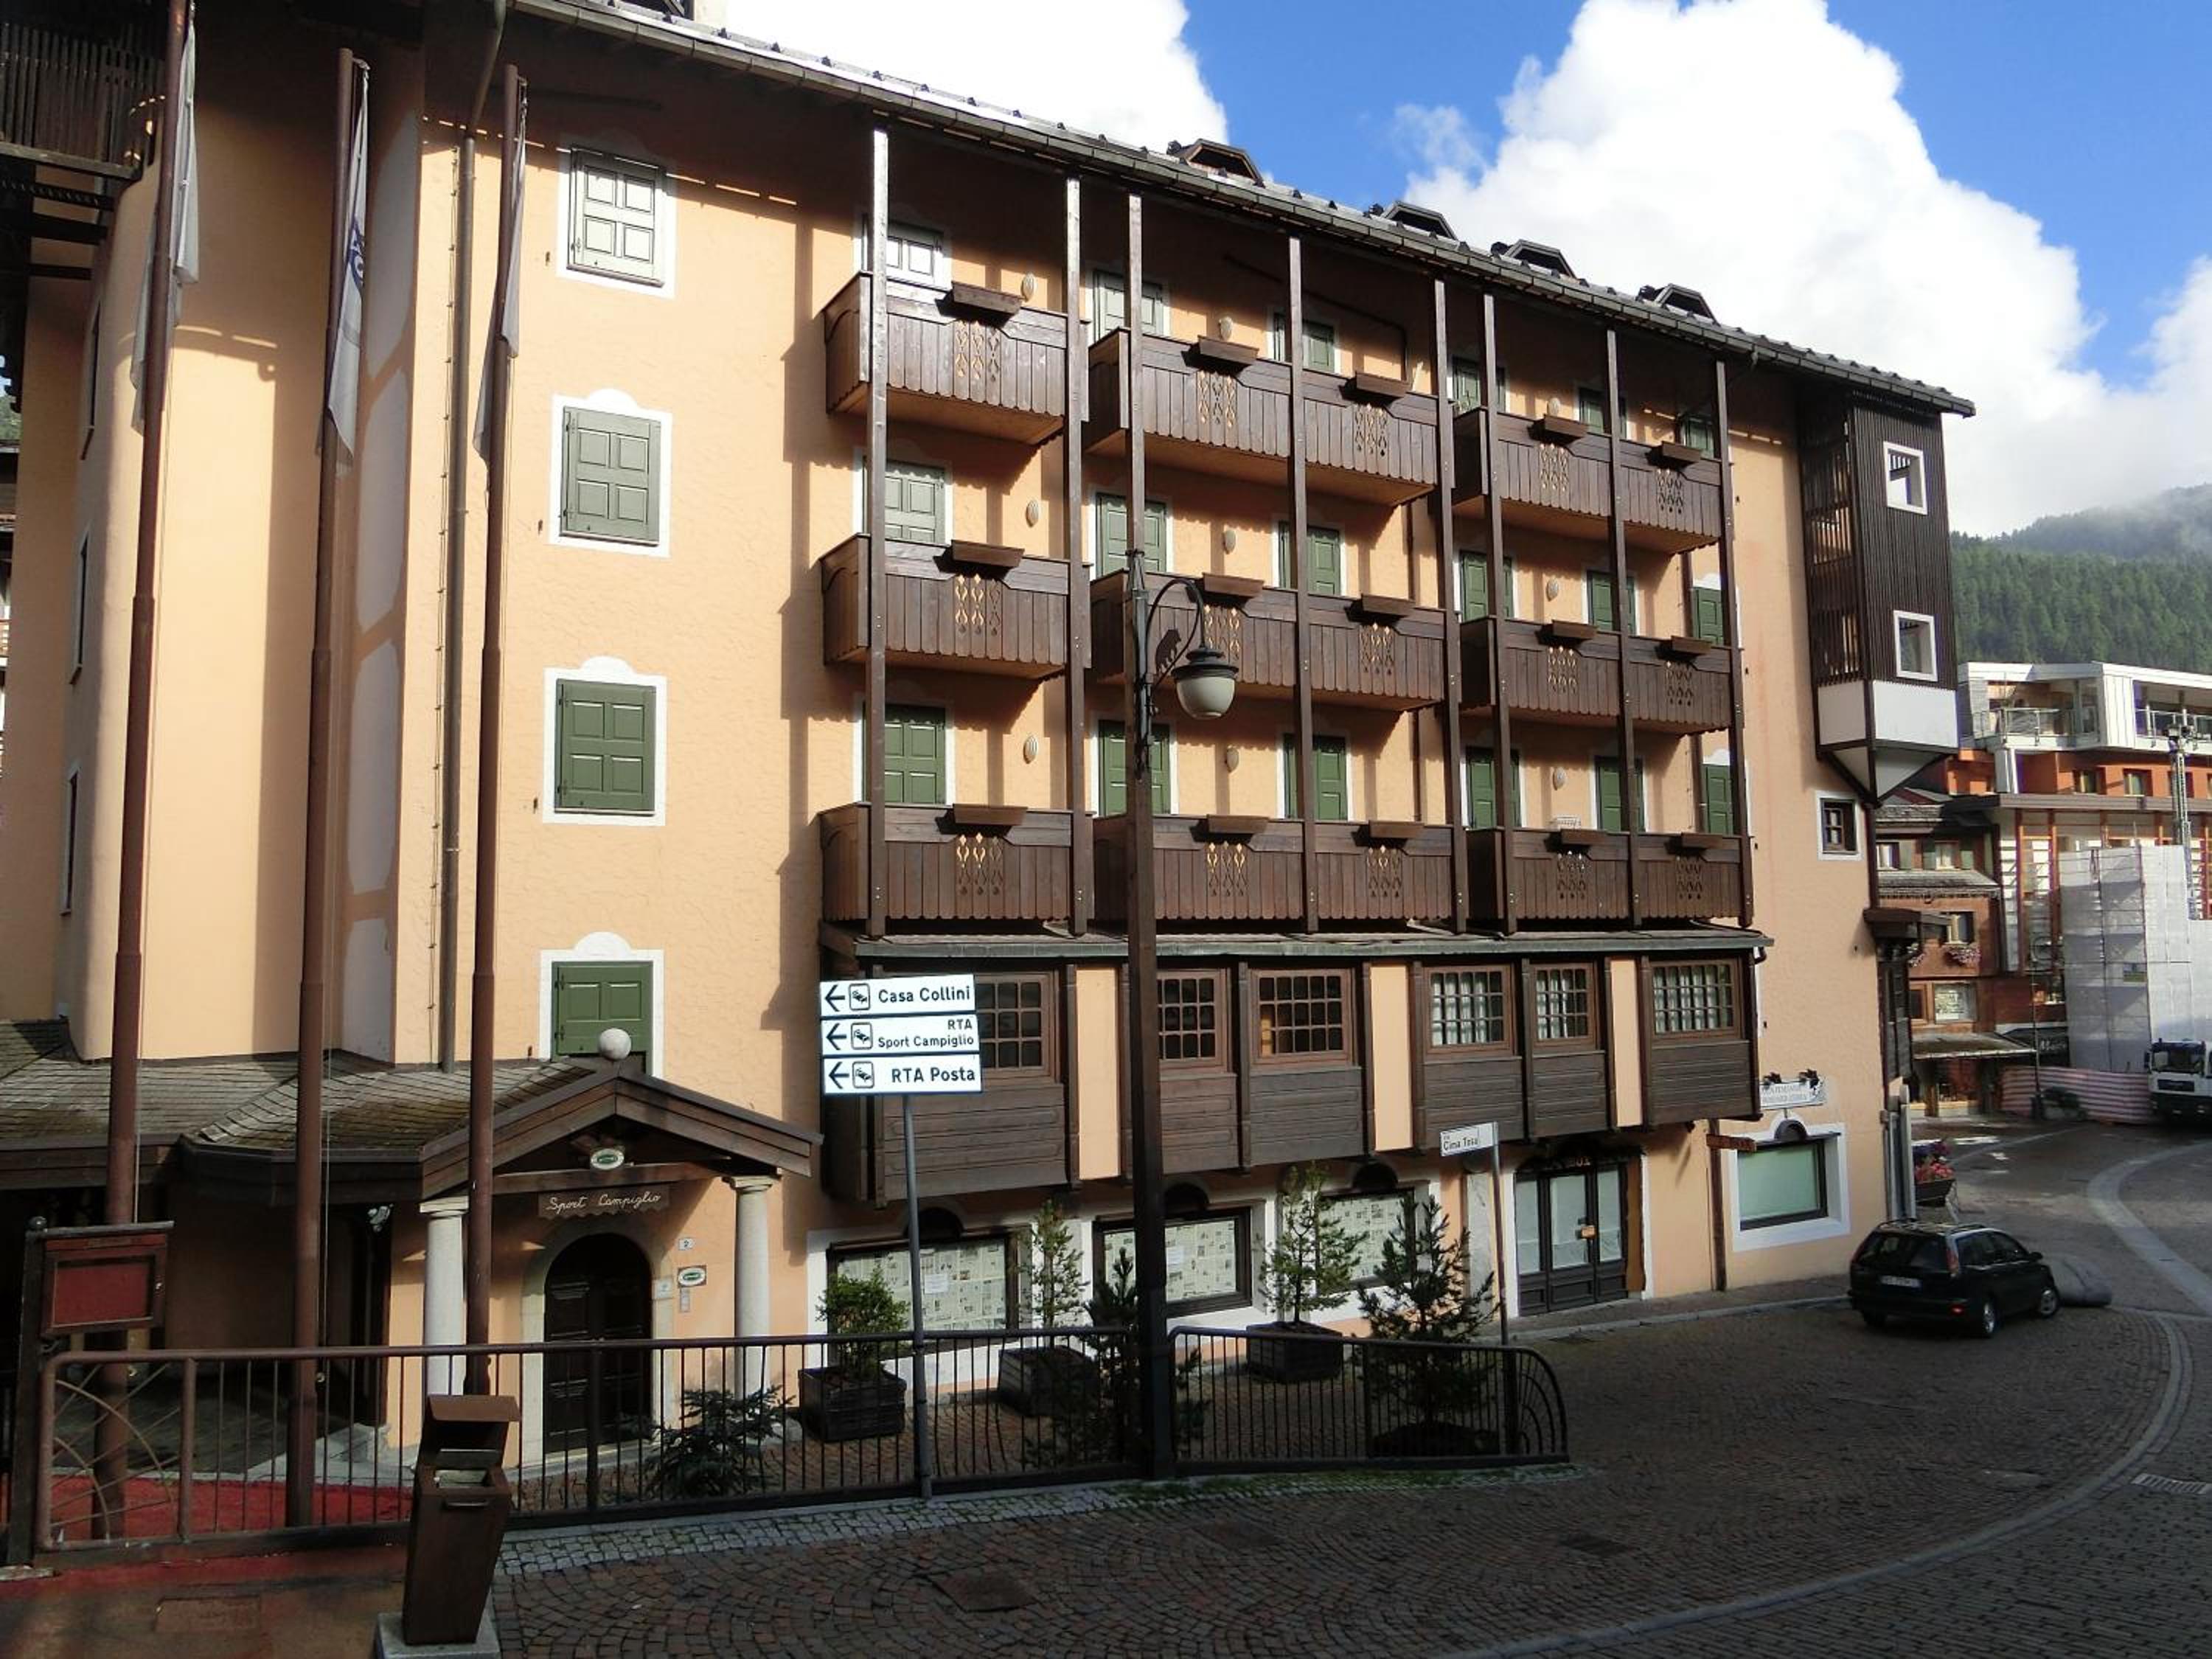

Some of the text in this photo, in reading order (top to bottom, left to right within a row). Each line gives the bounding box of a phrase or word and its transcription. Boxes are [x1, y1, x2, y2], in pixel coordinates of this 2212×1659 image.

[878, 986, 970, 1004] Casa Collini
[947, 1019, 973, 1030] RTA
[878, 1035, 975, 1049] Sport Campiglio
[891, 1067, 975, 1083] RTA Posta
[546, 1191, 661, 1214] Sport Campiglio
